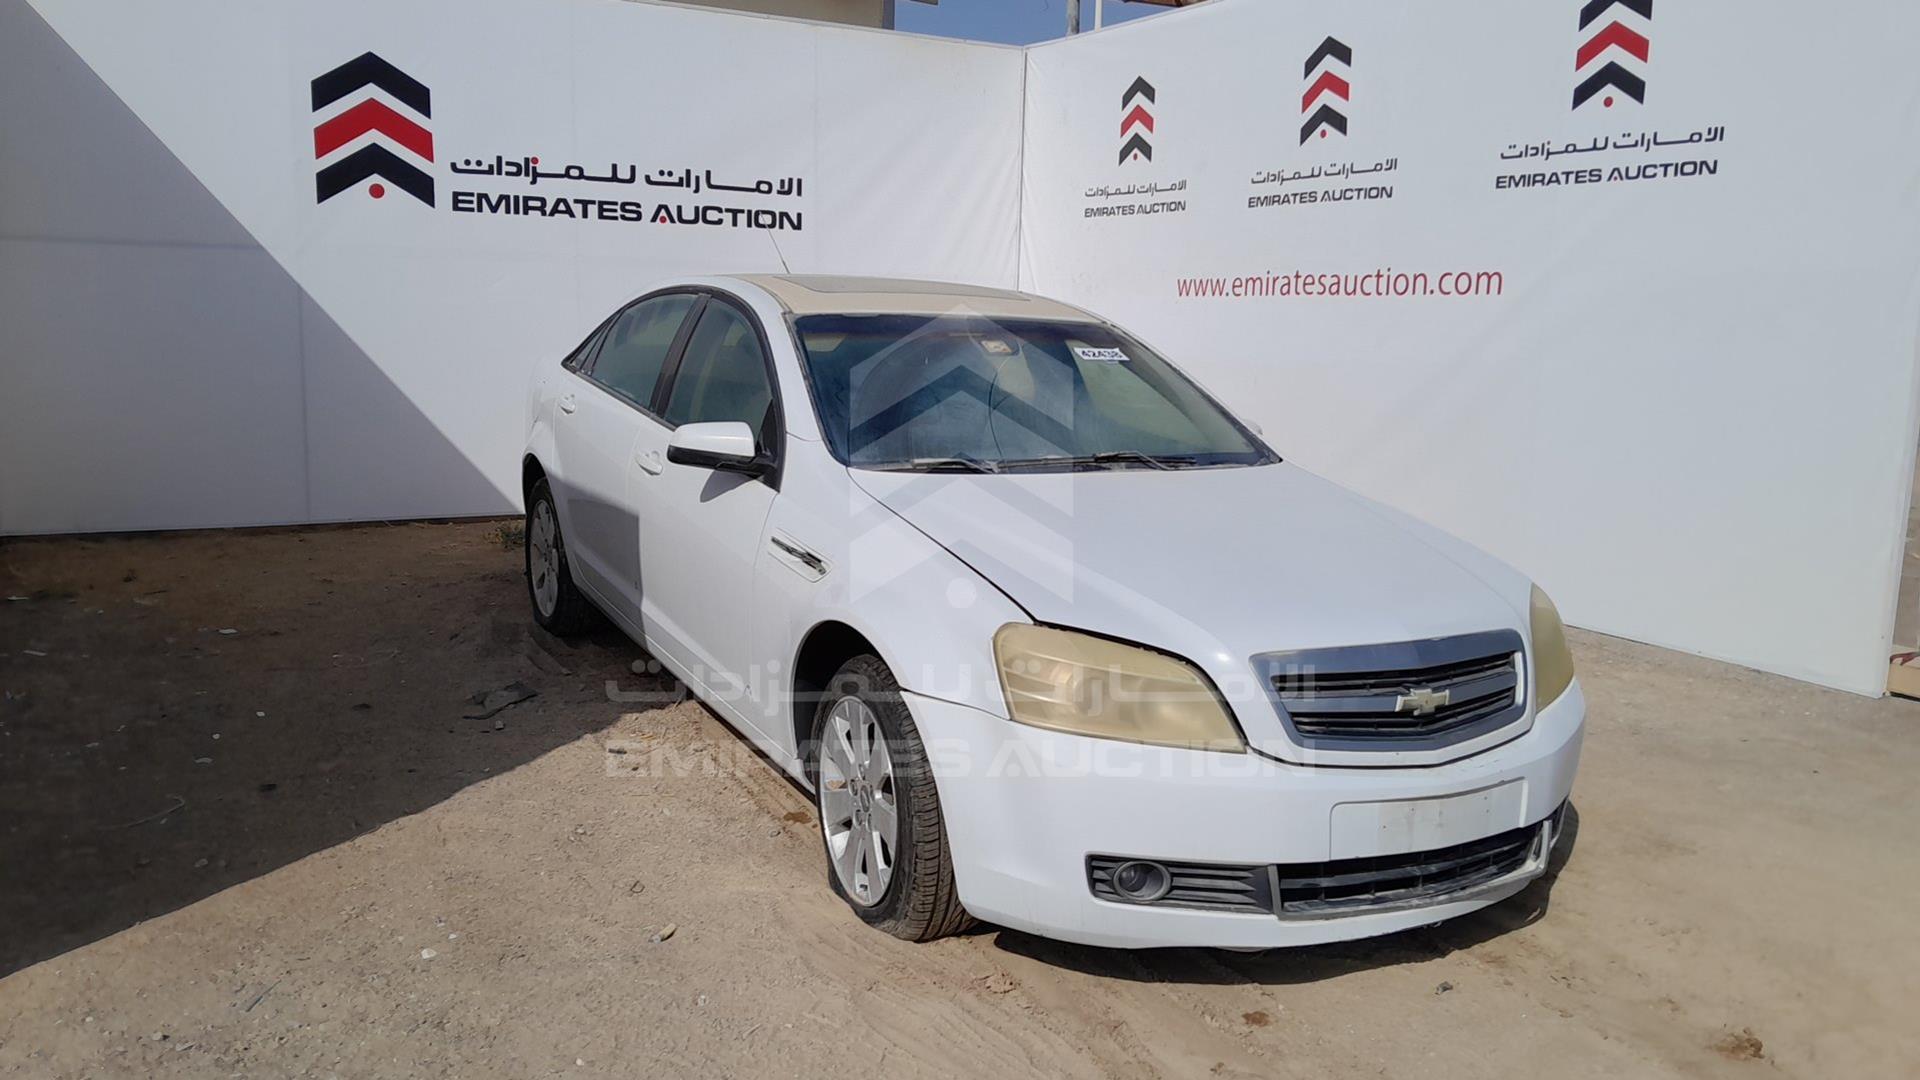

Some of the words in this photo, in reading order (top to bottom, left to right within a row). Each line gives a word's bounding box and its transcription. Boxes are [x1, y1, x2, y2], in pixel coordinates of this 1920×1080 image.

[1500, 136, 1609, 160] للمزادات
[1612, 126, 1725, 152] الامارات
[450, 155, 636, 185] للمزادات
[645, 168, 802, 197] الامارات
[1250, 166, 1322, 185] للمزادات
[1495, 168, 1602, 189] EMIRATES
[1607, 160, 1718, 182] AUCTION
[451, 190, 643, 221] EMIRATES
[650, 203, 802, 230] AUCTION
[1084, 204, 1135, 218] EMIRATES
[1136, 200, 1187, 215] AUCTION
[1247, 191, 1318, 208] EMIRATES
[1320, 186, 1393, 203] AUCTION
[1177, 267, 1503, 297] www.emiratesauction.com
